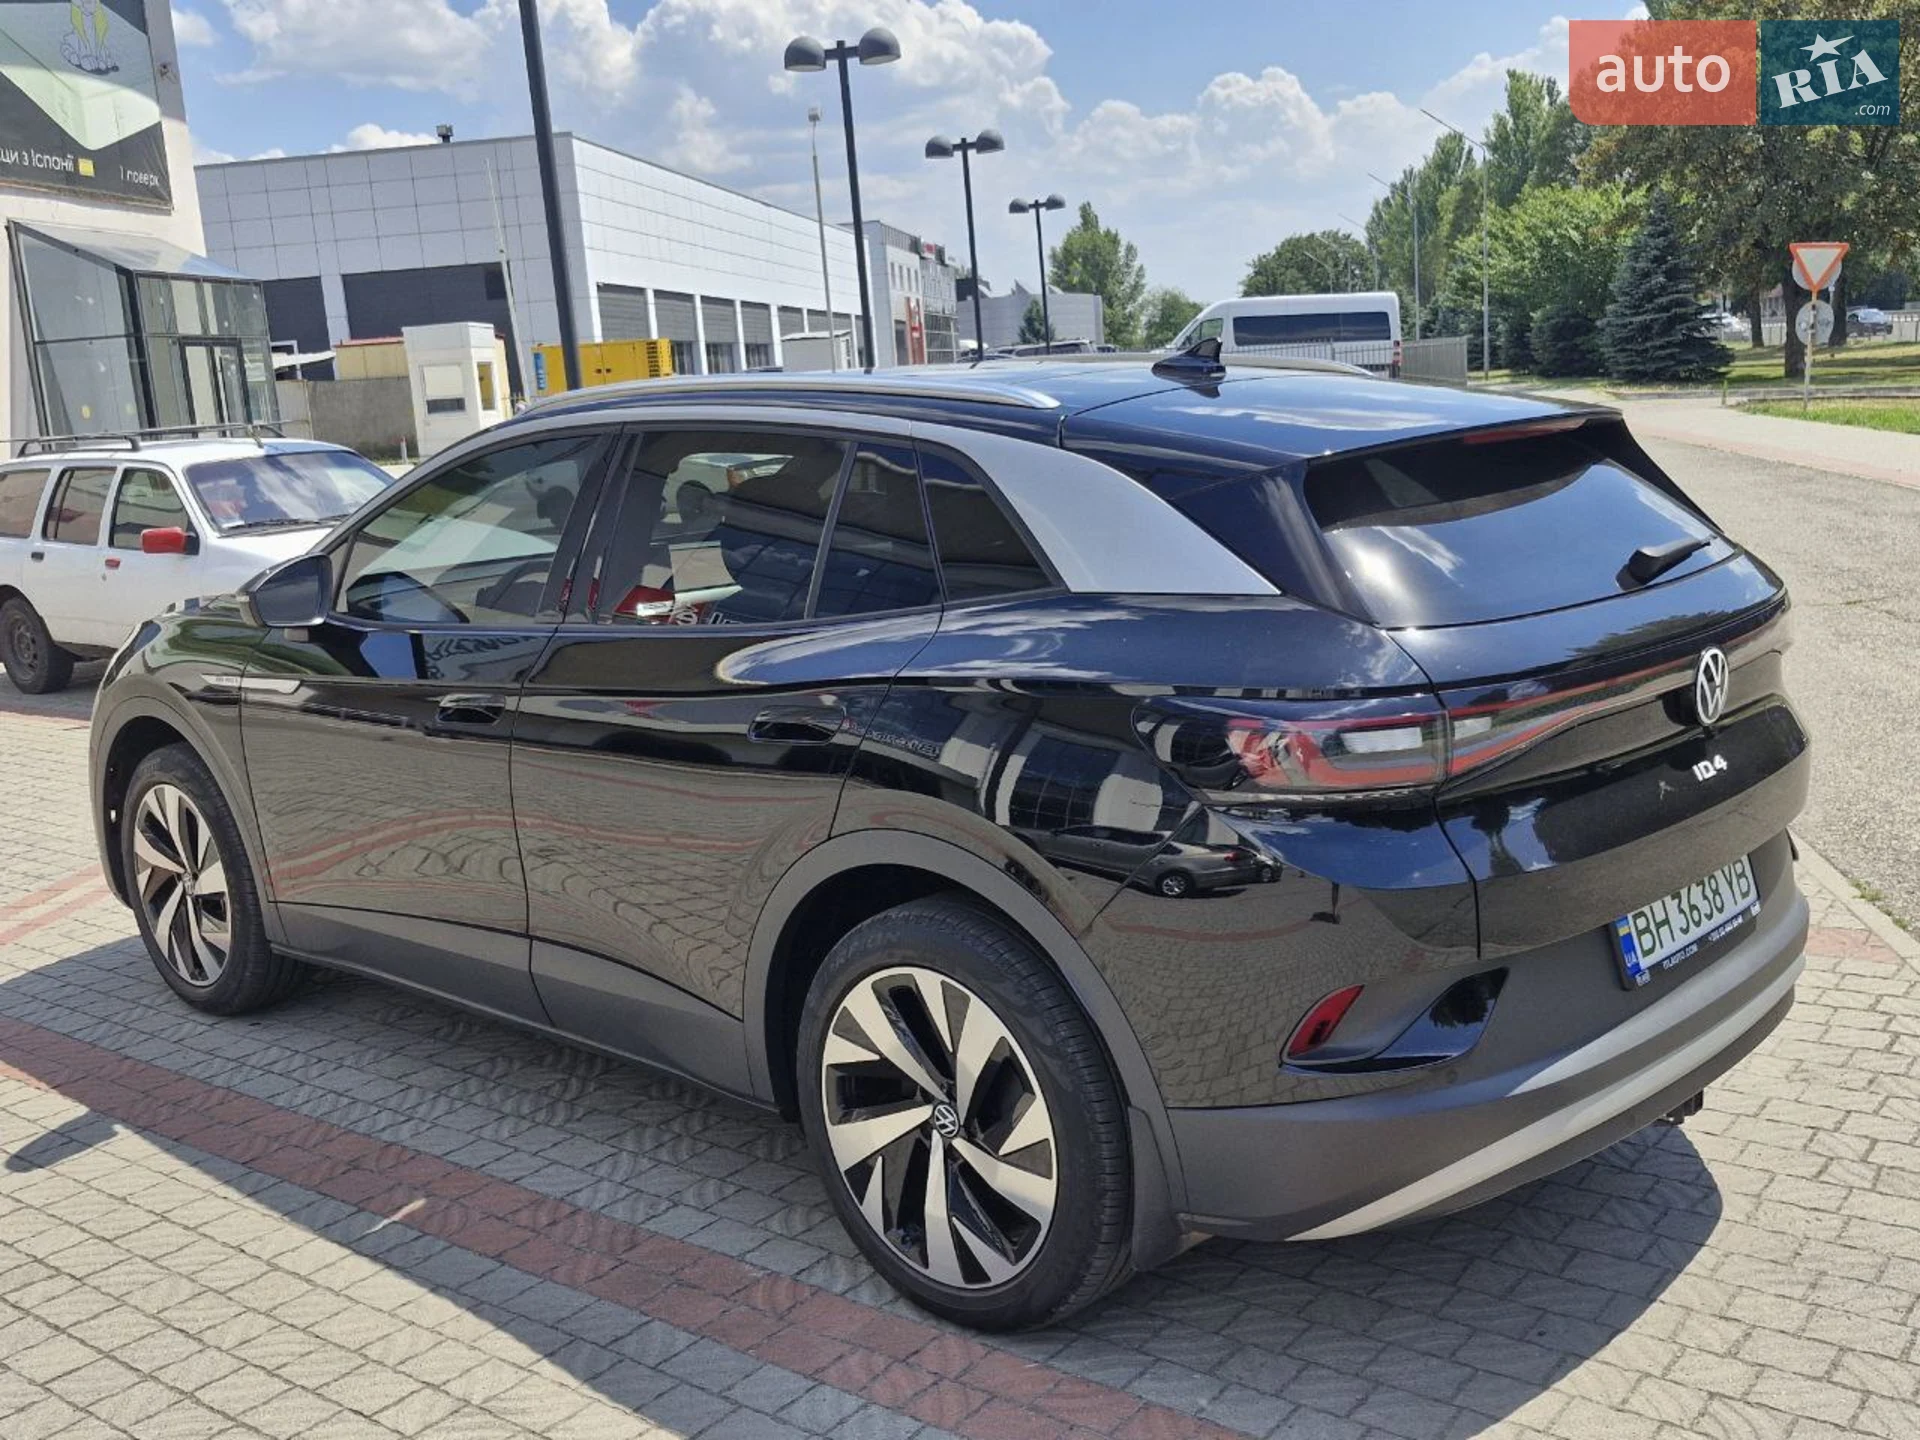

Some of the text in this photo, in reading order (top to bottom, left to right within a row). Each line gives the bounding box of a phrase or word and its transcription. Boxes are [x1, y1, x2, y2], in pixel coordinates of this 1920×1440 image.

[1631, 899, 1676, 958] BH
[1670, 873, 1725, 936] 3638
[1720, 858, 1751, 907] YB
